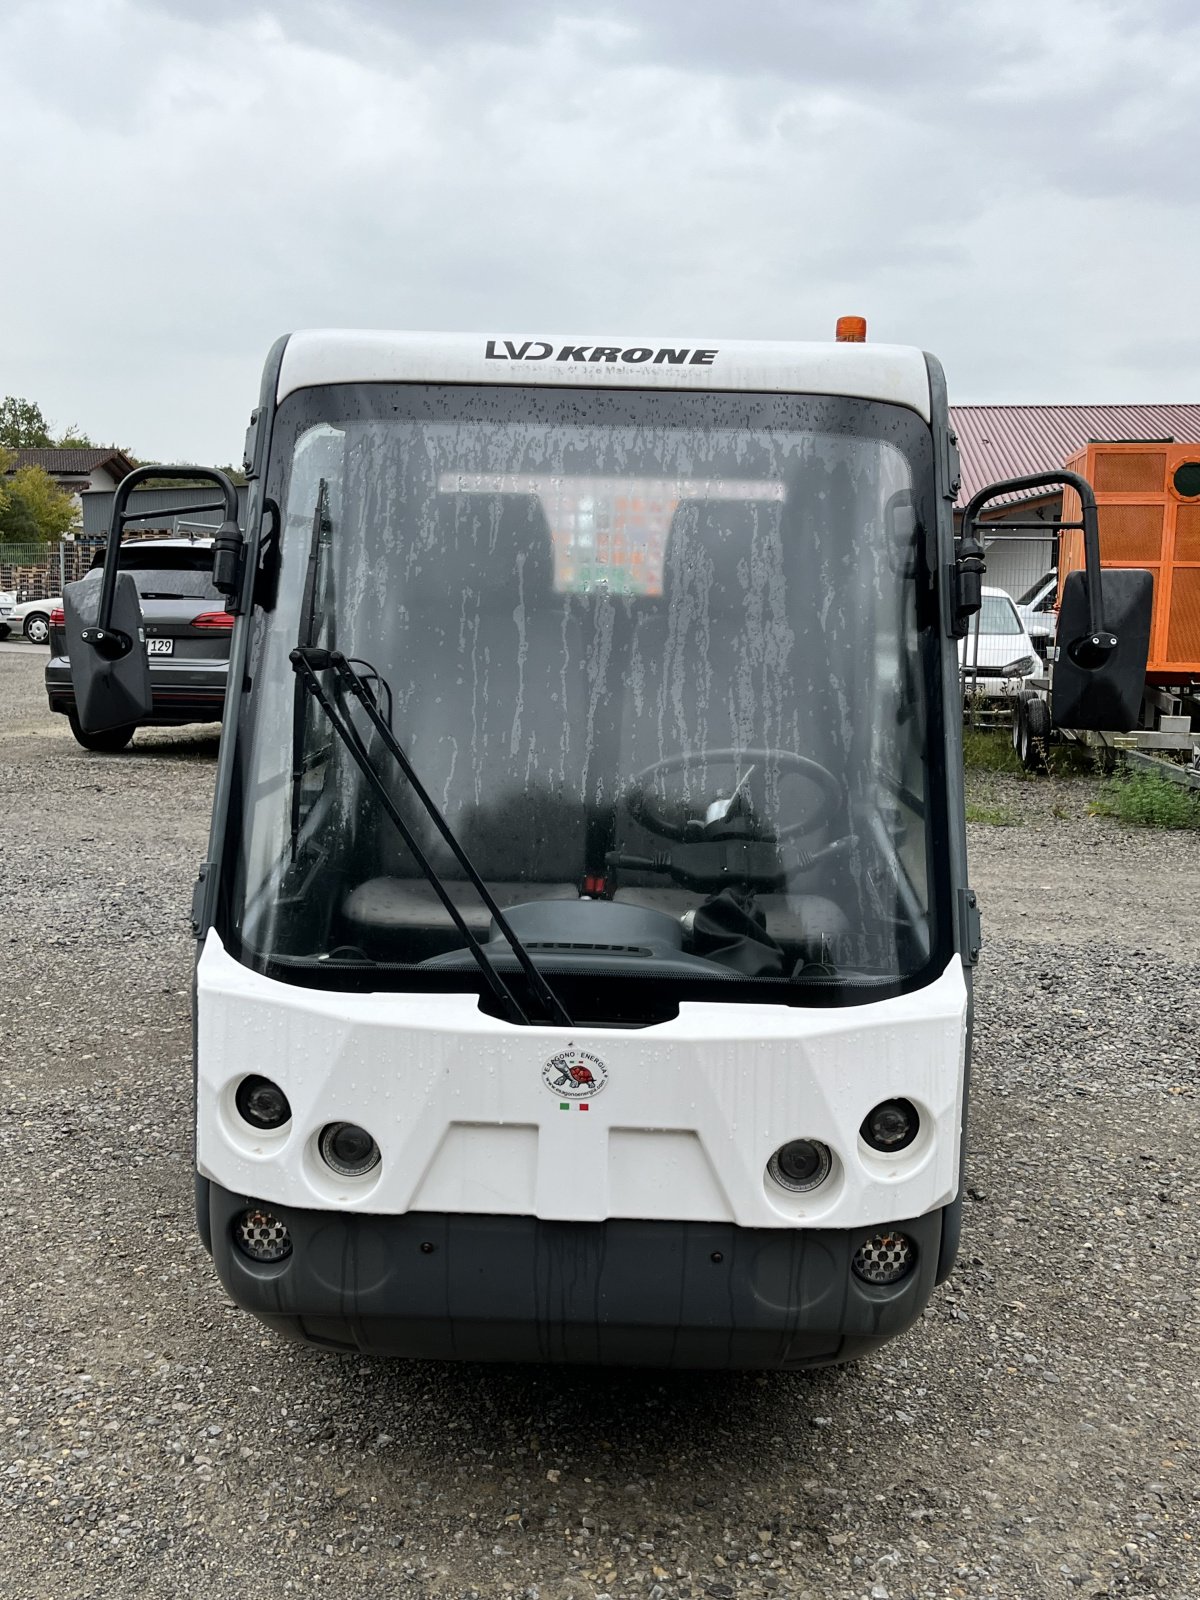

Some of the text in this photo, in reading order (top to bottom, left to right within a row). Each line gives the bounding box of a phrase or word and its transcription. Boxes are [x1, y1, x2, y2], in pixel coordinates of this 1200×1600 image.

[485, 341, 719, 365] LVD KRONE
[580, 1052, 607, 1074] ENERGIA
